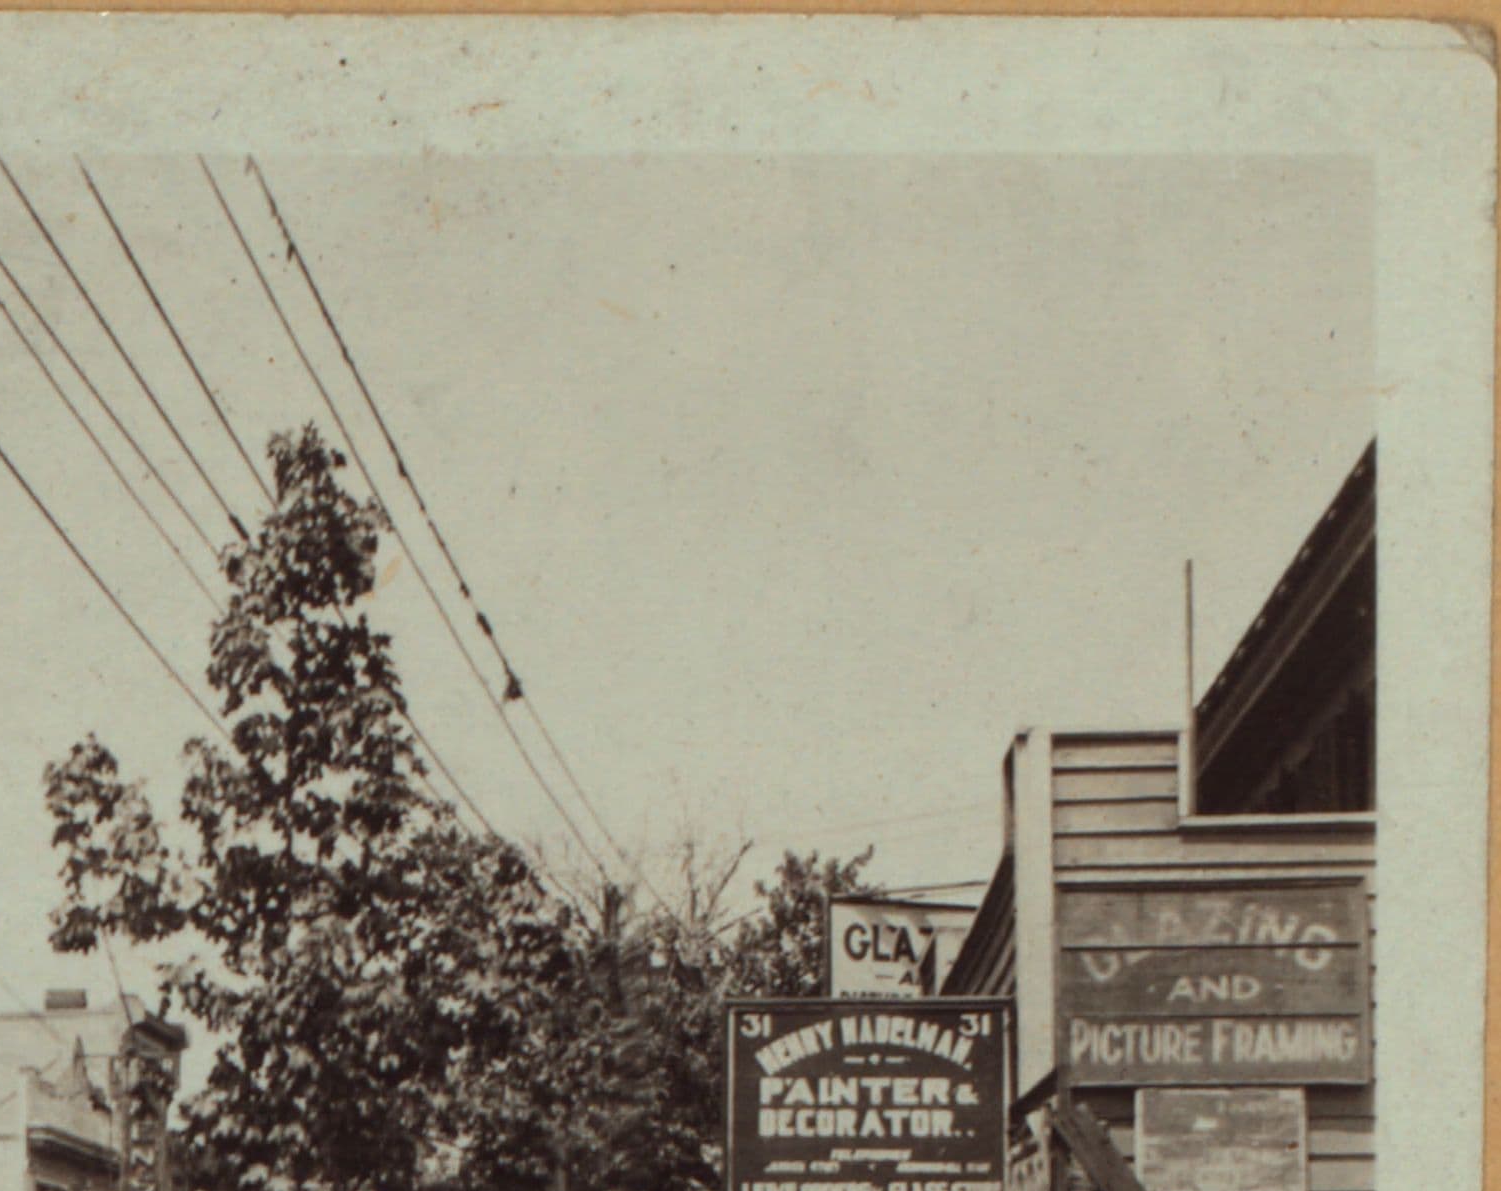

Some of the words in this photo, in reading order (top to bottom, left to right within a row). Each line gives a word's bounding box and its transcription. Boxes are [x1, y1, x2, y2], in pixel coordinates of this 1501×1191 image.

[1165, 975, 1261, 1004] AND
[740, 1013, 772, 1038] 31
[958, 1013, 992, 1037] 31
[1069, 1017, 1201, 1066] PICTURE
[1211, 1017, 1358, 1065] FRAMING
[759, 1077, 951, 1106] PAINTER
[955, 1083, 980, 1106] &
